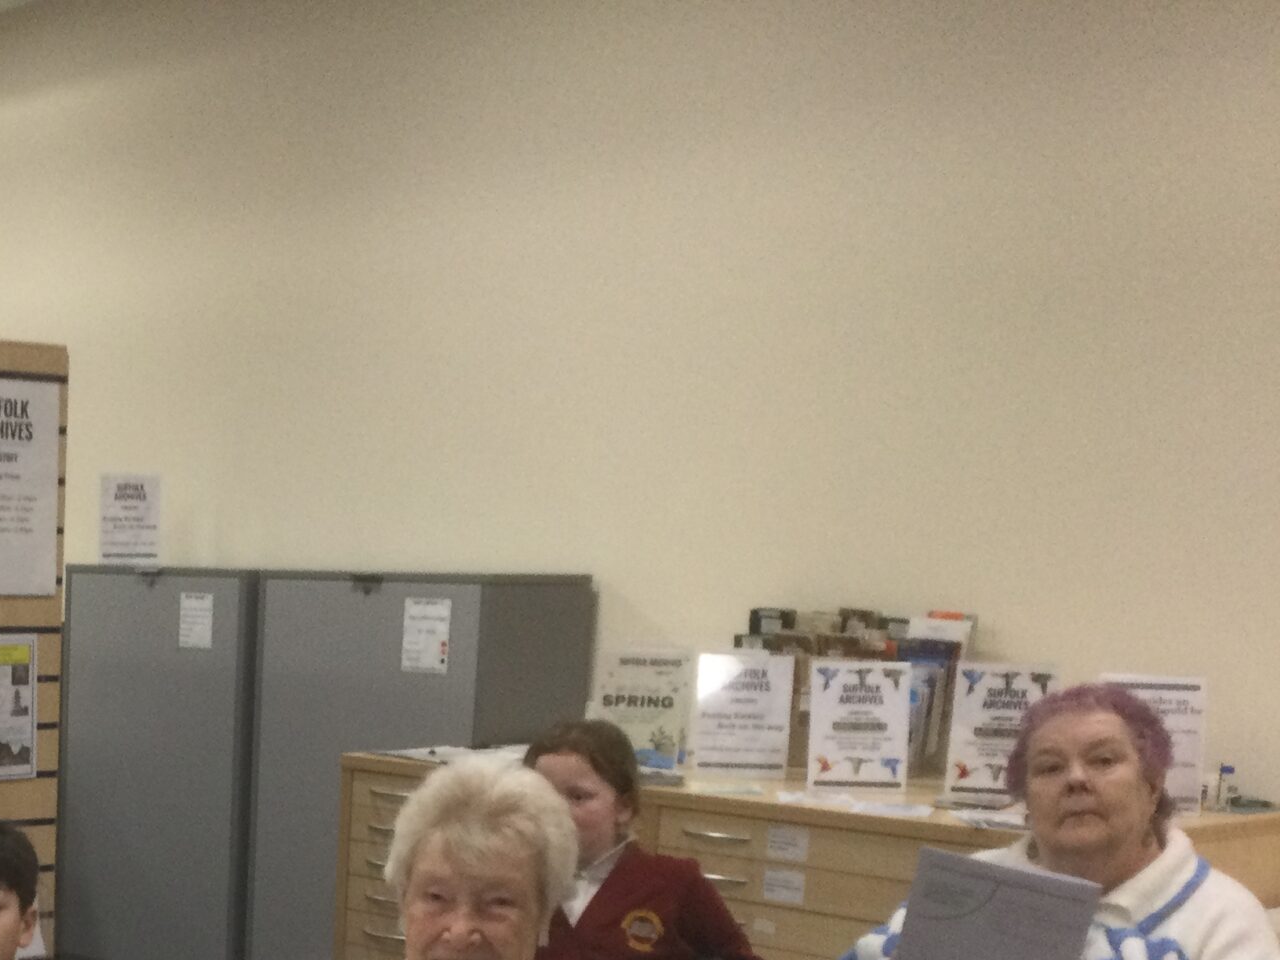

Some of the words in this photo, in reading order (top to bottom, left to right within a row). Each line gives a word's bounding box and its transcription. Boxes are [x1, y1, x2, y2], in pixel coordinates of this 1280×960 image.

[842, 683, 882, 694] SUFFOLK
[986, 688, 1028, 699] SUFFOLK
[602, 693, 674, 709] SPRING
[838, 694, 884, 705] ARCHIVES
